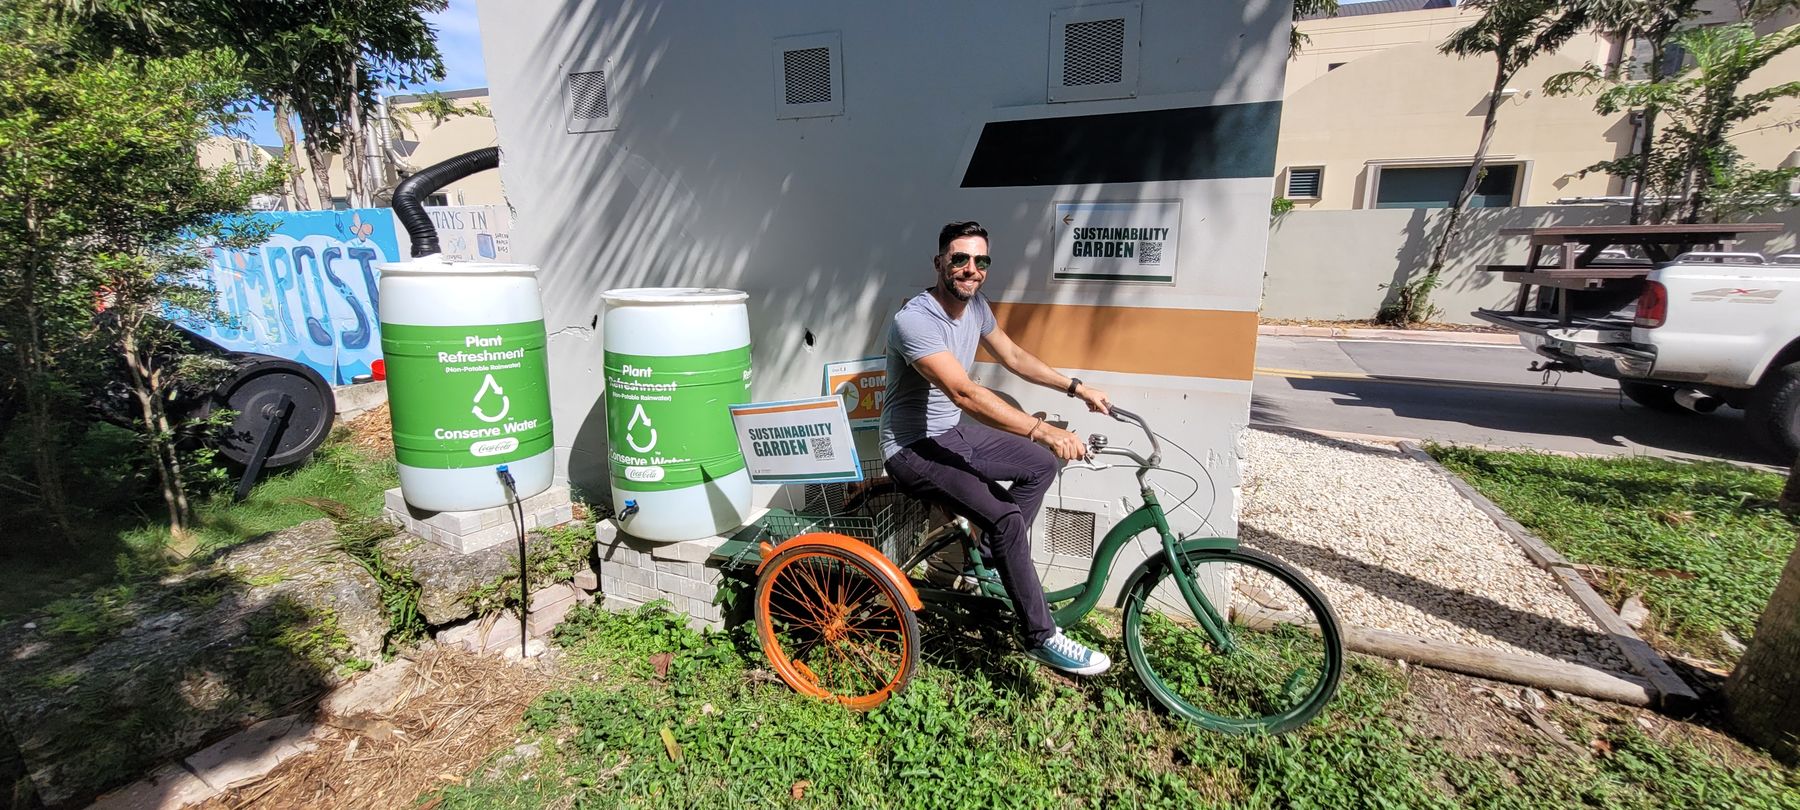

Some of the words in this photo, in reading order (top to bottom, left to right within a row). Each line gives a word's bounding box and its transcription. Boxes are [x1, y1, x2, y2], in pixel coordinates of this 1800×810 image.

[428, 211, 465, 230] TAYS
[468, 211, 489, 230] IN
[1073, 227, 1169, 241] SUSTAINABILITY
[1072, 241, 1135, 258] GARDEN
[196, 246, 382, 350] OMPOST
[465, 334, 503, 348] Plant
[437, 346, 525, 364] Refreshment
[445, 365, 489, 374] (Non-Potable
[490, 362, 521, 371] Rainwater)
[622, 364, 653, 378] Plant
[608, 375, 678, 392] Refreshment
[861, 394, 874, 411] 4
[434, 427, 500, 440] Conserve
[503, 418, 538, 434] Water
[748, 422, 832, 441] SUSTAINABILITY
[753, 438, 809, 458] GARDEN
